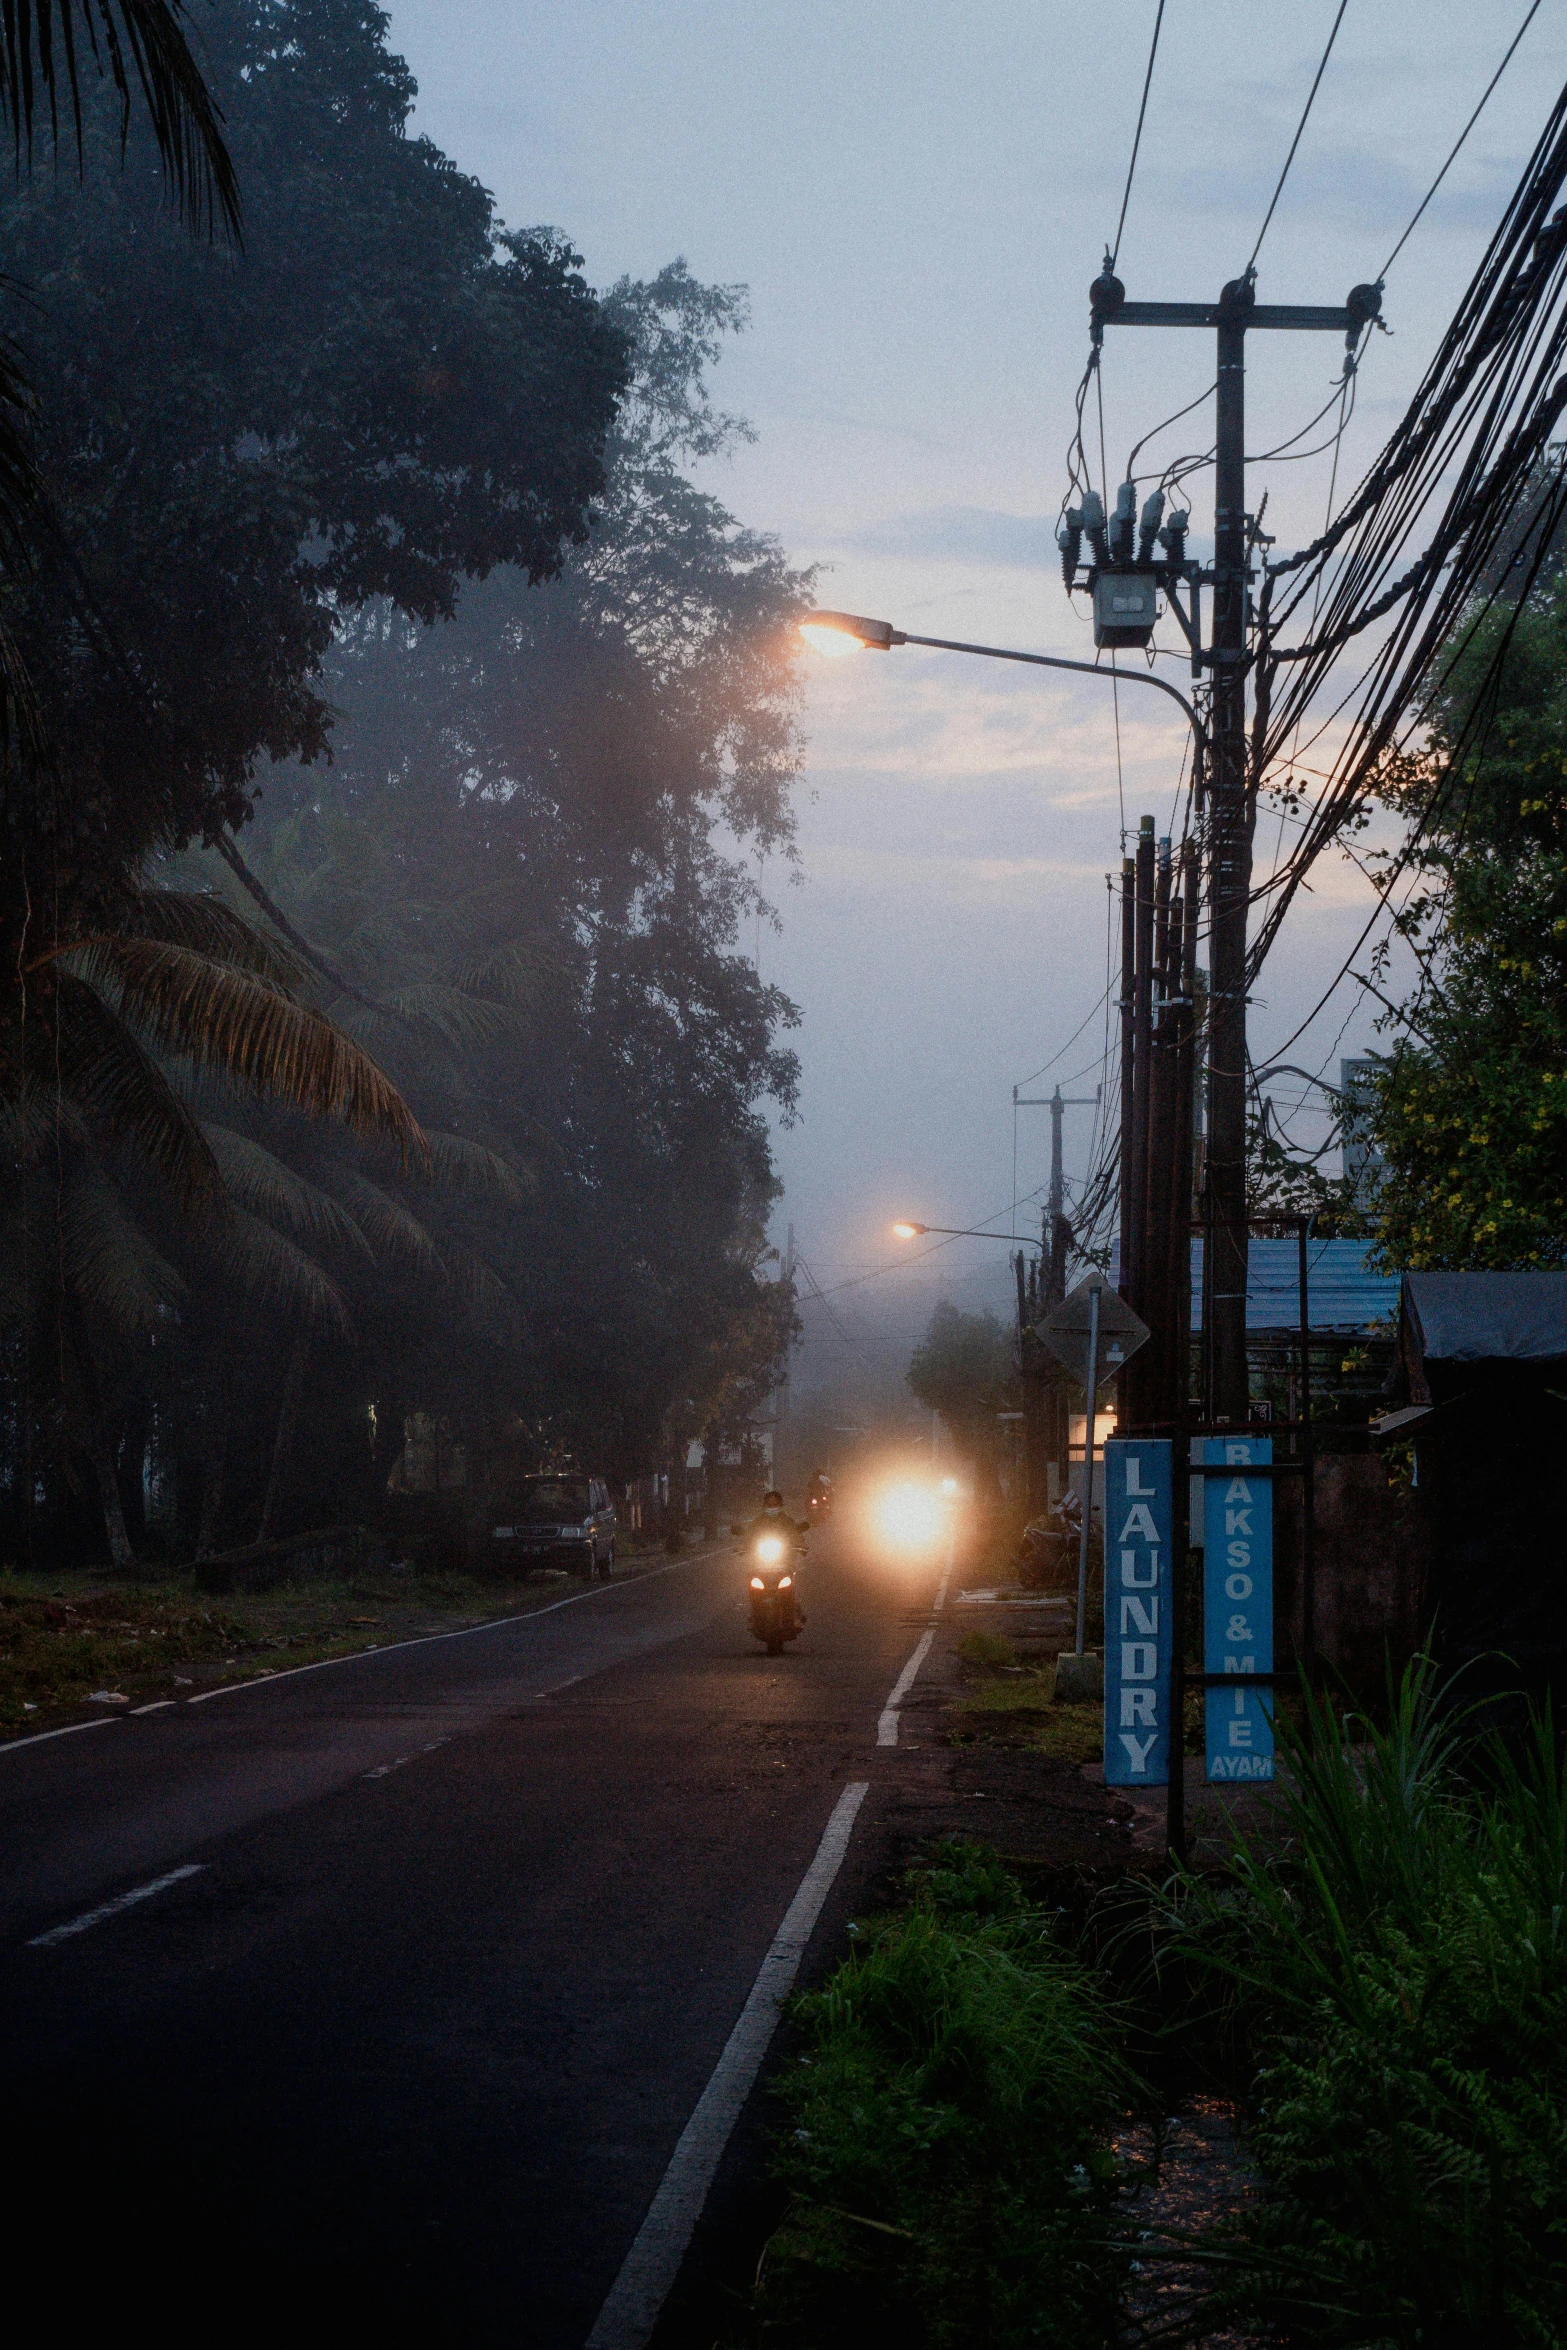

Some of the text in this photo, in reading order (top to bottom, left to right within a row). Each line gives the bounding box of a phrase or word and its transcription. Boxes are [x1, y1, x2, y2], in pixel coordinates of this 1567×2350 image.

[1118, 1457, 1161, 1773] LAUNDRY
[1223, 1444, 1255, 1747] BAKSO & MIE
[1210, 1756, 1272, 1777] AYAM
